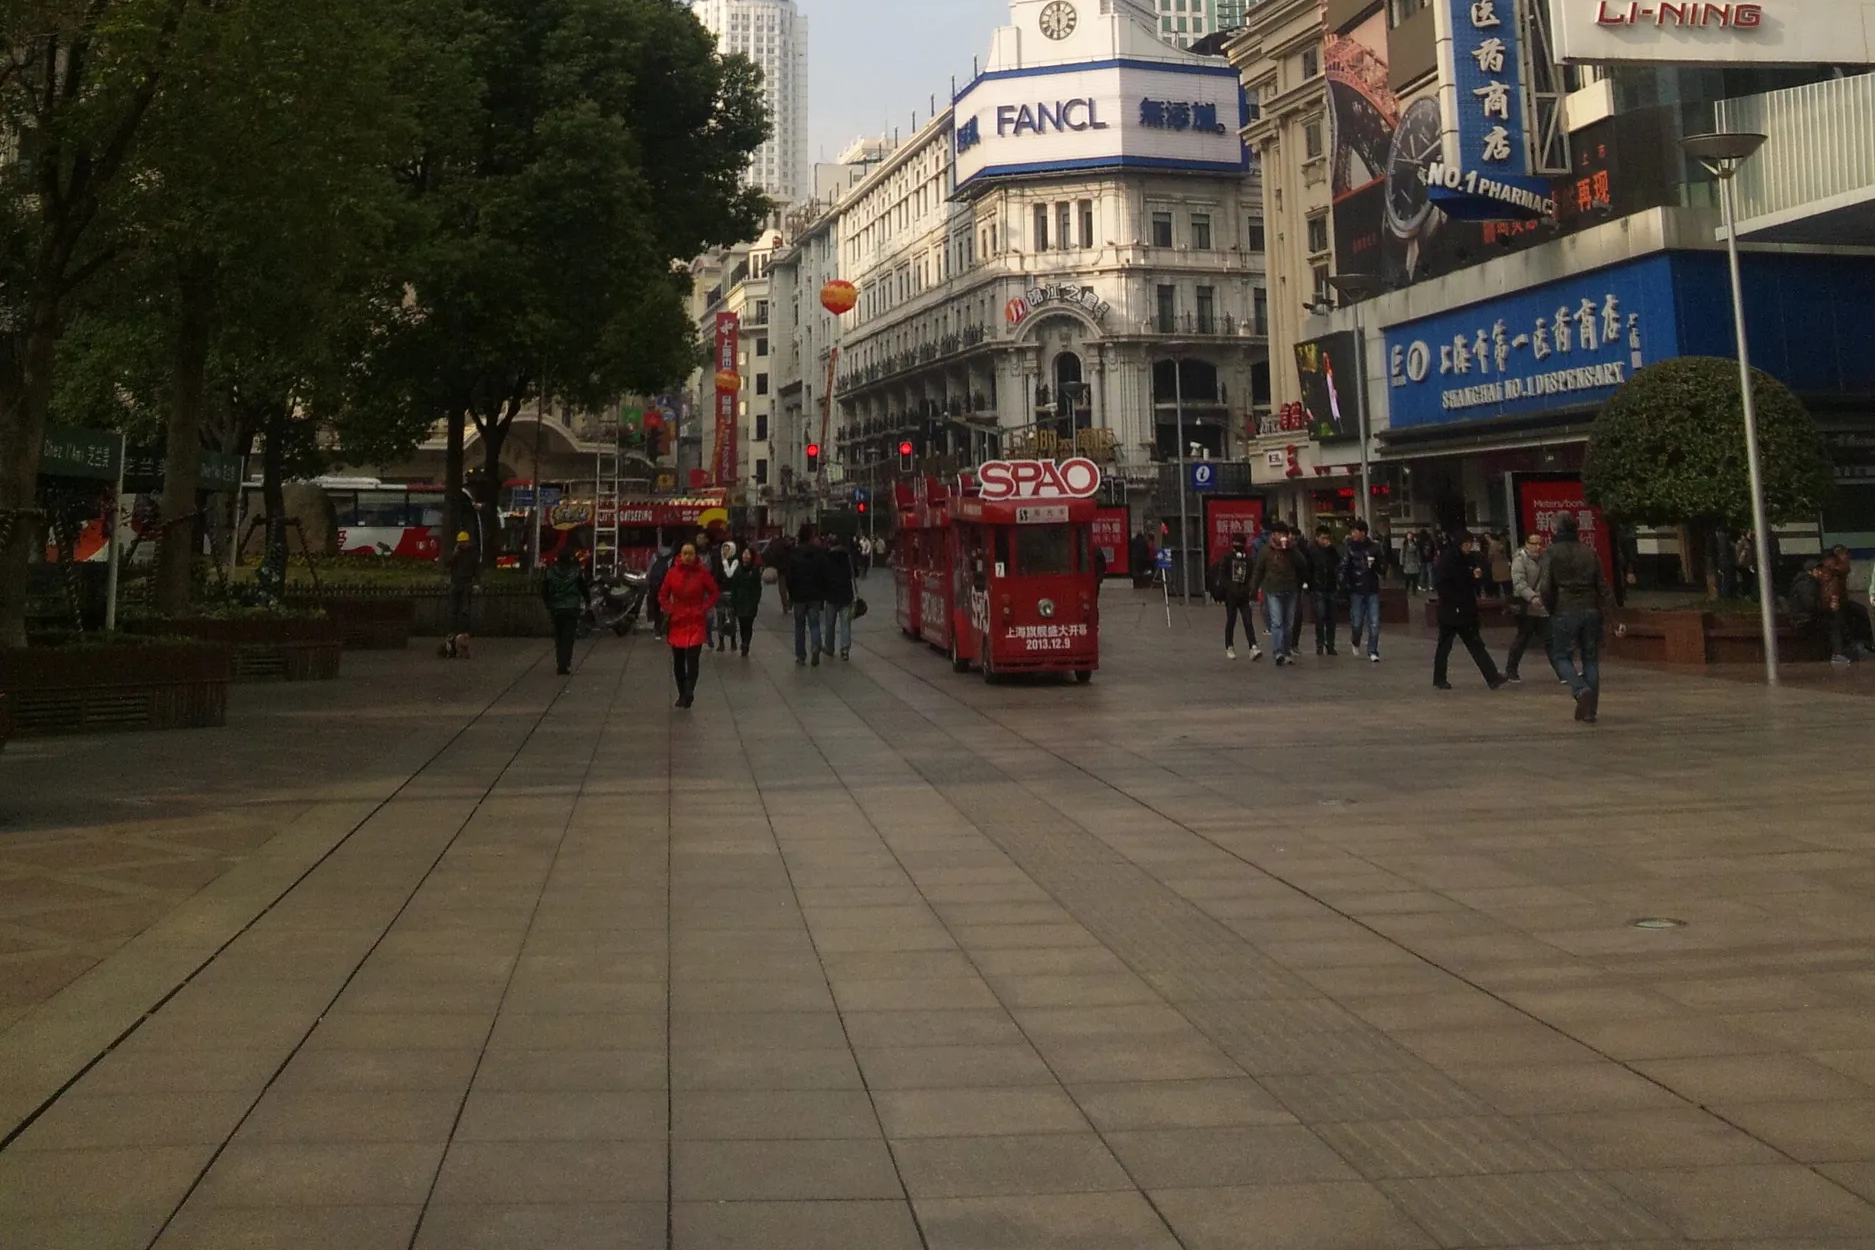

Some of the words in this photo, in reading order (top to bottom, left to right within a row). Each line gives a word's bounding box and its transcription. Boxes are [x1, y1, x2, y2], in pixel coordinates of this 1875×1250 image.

[1596, 0, 1762, 29] LI-NING
[997, 97, 1109, 137] FANCL
[1478, 178, 1557, 216] PHARMAC
[1442, 382, 1502, 410] SHANGHAI
[1536, 361, 1625, 395] DISPENSARY
[978, 457, 1100, 500] SPAO
[1026, 637, 1071, 651] 2013.12.9
